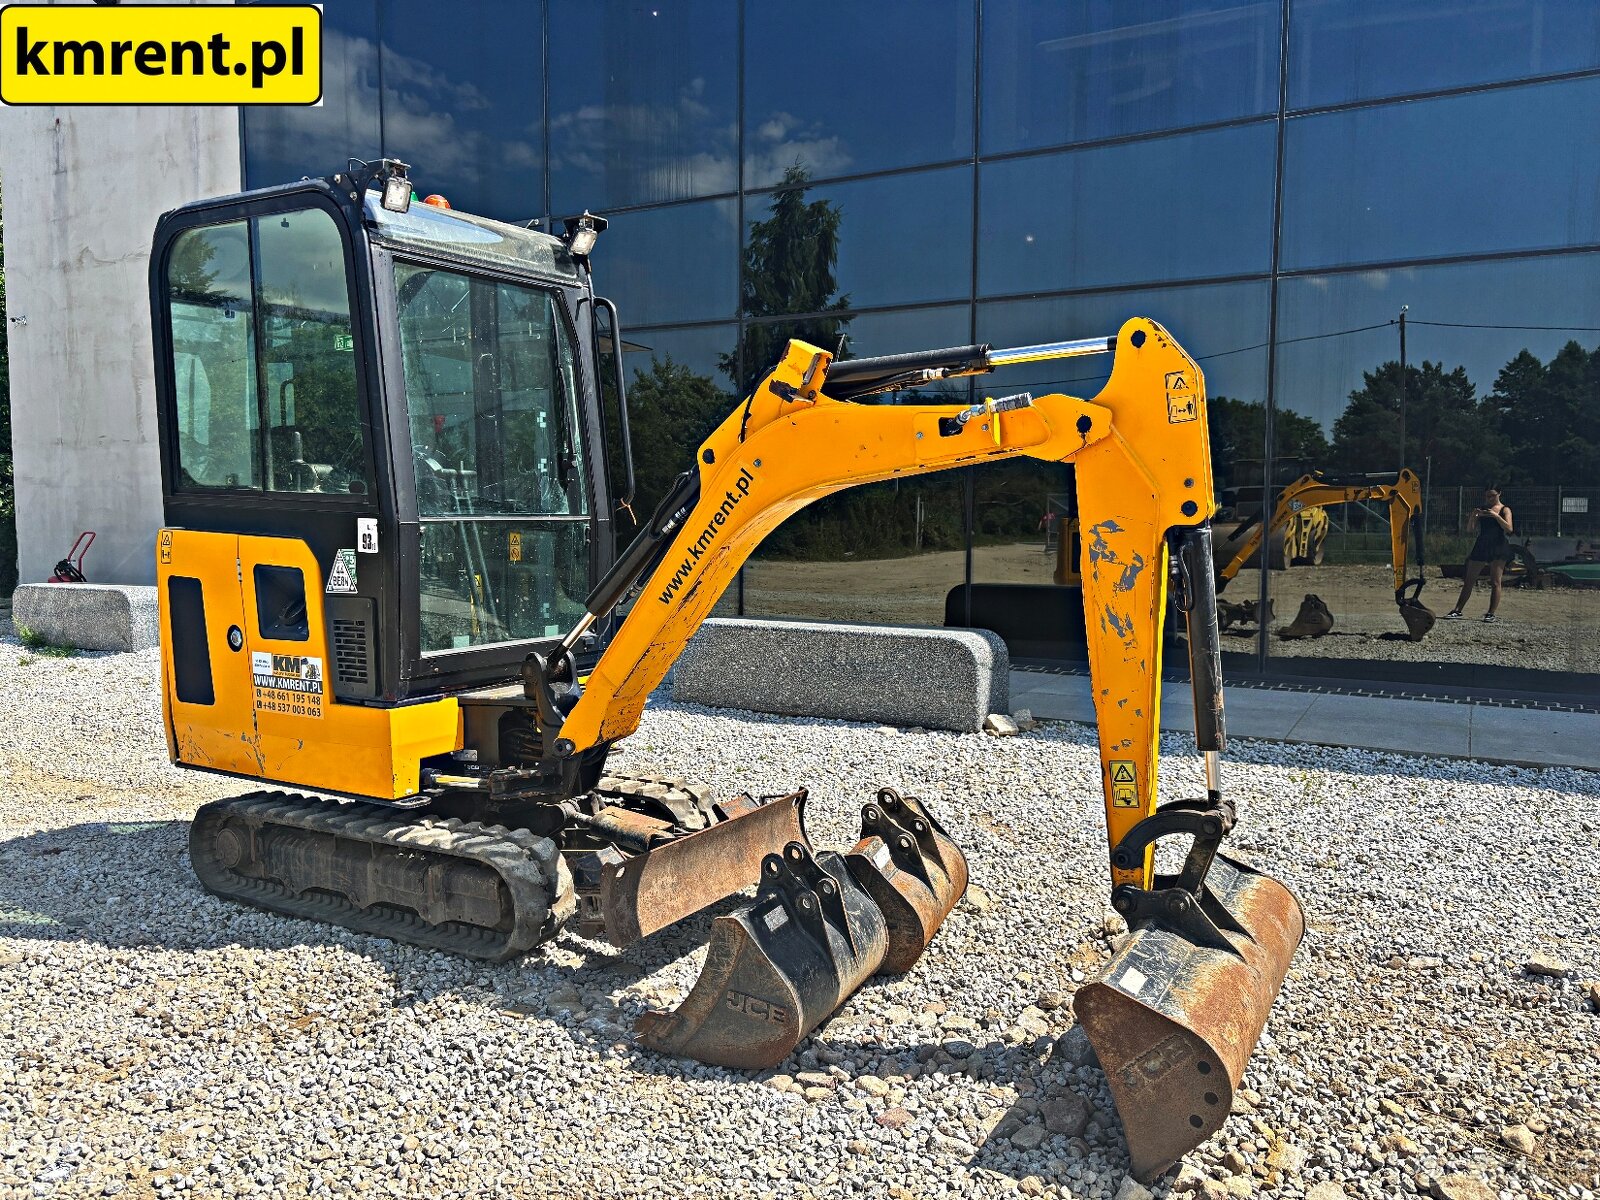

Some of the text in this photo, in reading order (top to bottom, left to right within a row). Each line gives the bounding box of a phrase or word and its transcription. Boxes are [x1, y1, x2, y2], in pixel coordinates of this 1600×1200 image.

[362, 532, 372, 550] 93
[658, 467, 754, 605] www.kmrent.pl
[273, 655, 301, 674] KM
[253, 674, 323, 694] WWW.KMRENT.PL
[262, 690, 321, 706] +48 661 195 148
[263, 701, 321, 718] +48 537 003 063
[725, 989, 787, 1025] JCB
